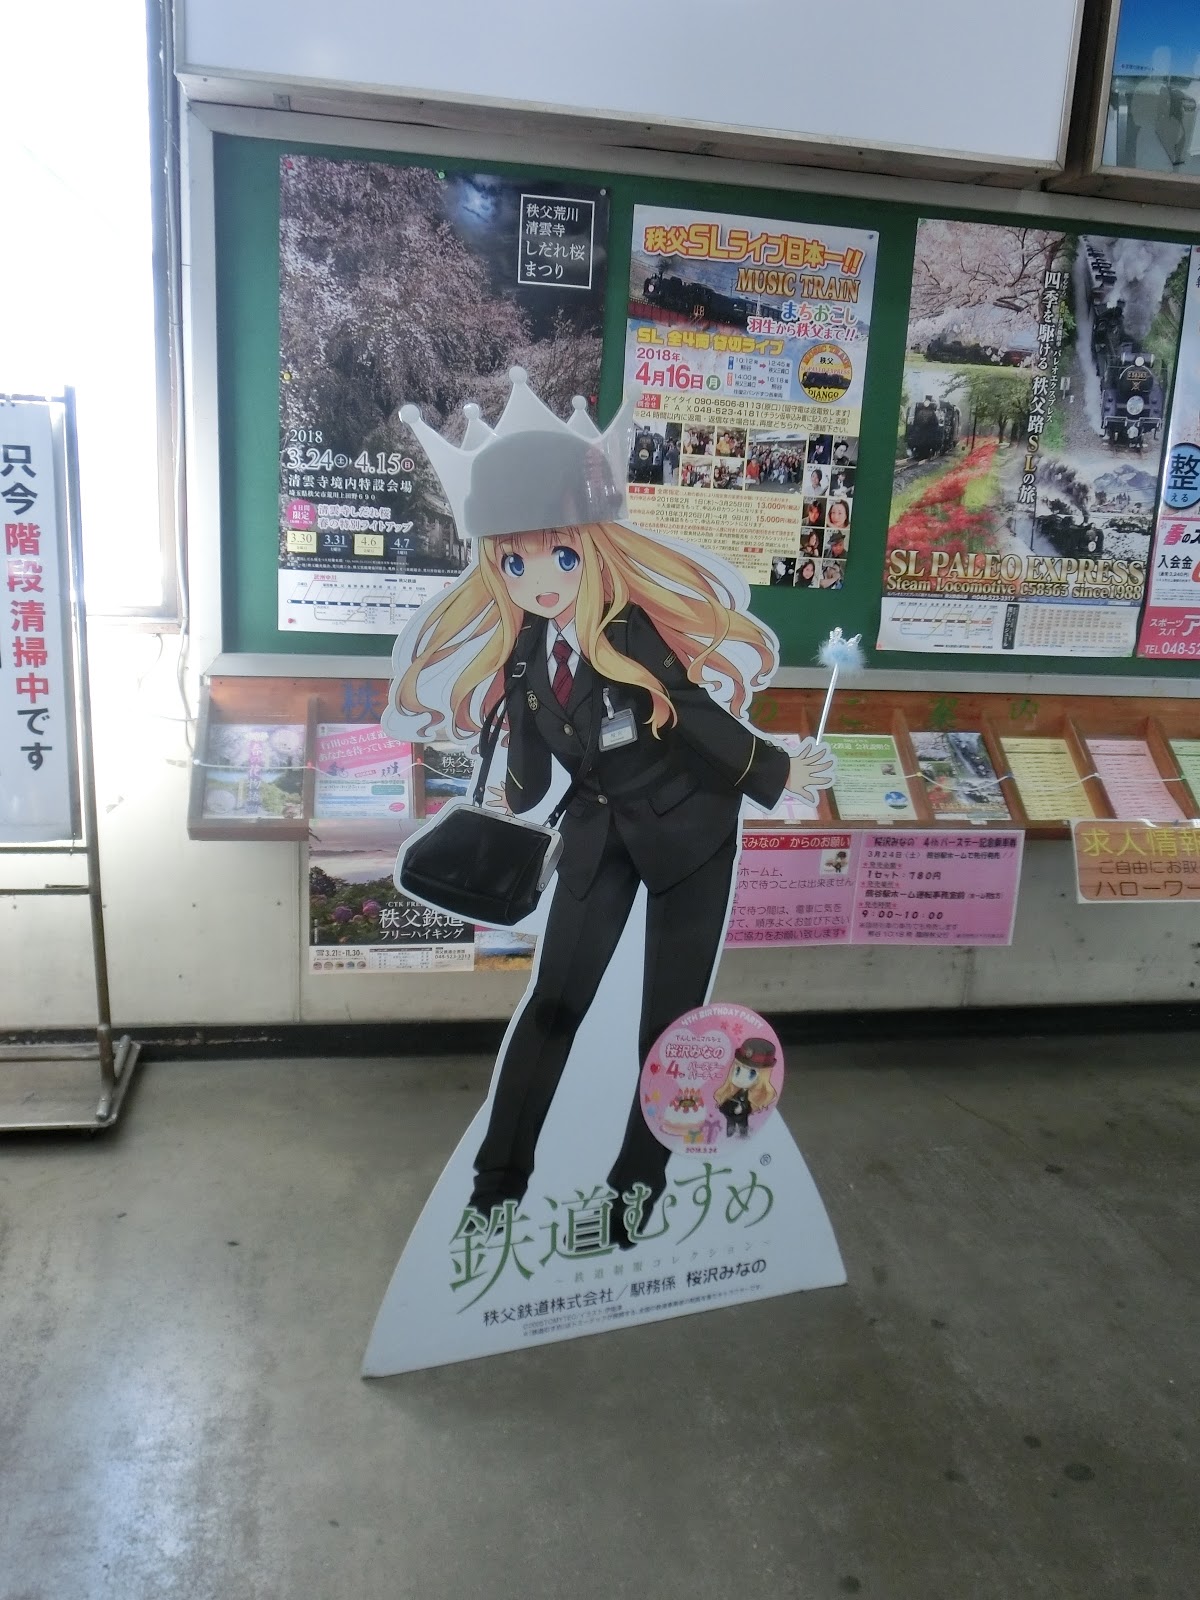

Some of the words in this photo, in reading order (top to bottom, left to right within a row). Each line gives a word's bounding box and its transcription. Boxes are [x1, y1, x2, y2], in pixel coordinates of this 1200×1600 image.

[525, 203, 579, 222] 秩父荒川
[525, 220, 566, 238] 清雲寺
[525, 240, 586, 261] しだれ桜
[643, 223, 864, 275] 秩父SLライブ日本一!!
[524, 261, 564, 279] まつり
[734, 268, 797, 298] MUSIC
[800, 273, 861, 303] TRAIN
[781, 301, 858, 325] まちおこし
[1037, 271, 1062, 371] 四季を駆ける
[636, 327, 664, 344] SL
[747, 318, 857, 342] 羽生から秩父まで!!
[636, 348, 681, 362] 2018年
[819, 356, 834, 365] 秩父
[635, 361, 704, 391] 4月16日
[708, 377, 720, 390] 月
[807, 389, 839, 399] DJANGO
[289, 429, 323, 443] 2018
[1019, 376, 1050, 504] 秩父路SLの旅
[1167, 454, 1200, 492] 整
[288, 474, 413, 494] 清雲寺境内特設会場
[1170, 493, 1189, 502] える
[292, 511, 310, 521] 限定
[317, 503, 392, 520] 清雲寺しだれ桜
[317, 517, 414, 534] 春の特別ライトアップ
[290, 532, 313, 544] 3.30
[324, 534, 347, 545] 3.31
[360, 536, 377, 546] 4.6
[393, 538, 410, 549] 4.7
[888, 548, 926, 577] SL
[930, 550, 1023, 583] PALEO
[1025, 555, 1147, 587] EXPRESS
[1157, 554, 1193, 570] 入会金
[886, 575, 931, 592] Steam
[935, 578, 1016, 595] Locomotive
[0, 444, 53, 771] 只今階段清掃中です
[1149, 618, 1184, 628] スポーツ
[735, 879, 854, 890] 内で待つことは出来ません
[379, 928, 465, 941] フリーハイキング
[681, 1013, 698, 1026] 4TH
[699, 1007, 739, 1018] BIRTHDAY
[739, 1011, 764, 1029] PARTY
[665, 1043, 724, 1060] 桜沢みなの
[449, 1161, 775, 1314] 鉄道むすめ
[686, 1258, 768, 1288] 桜沢みなの
